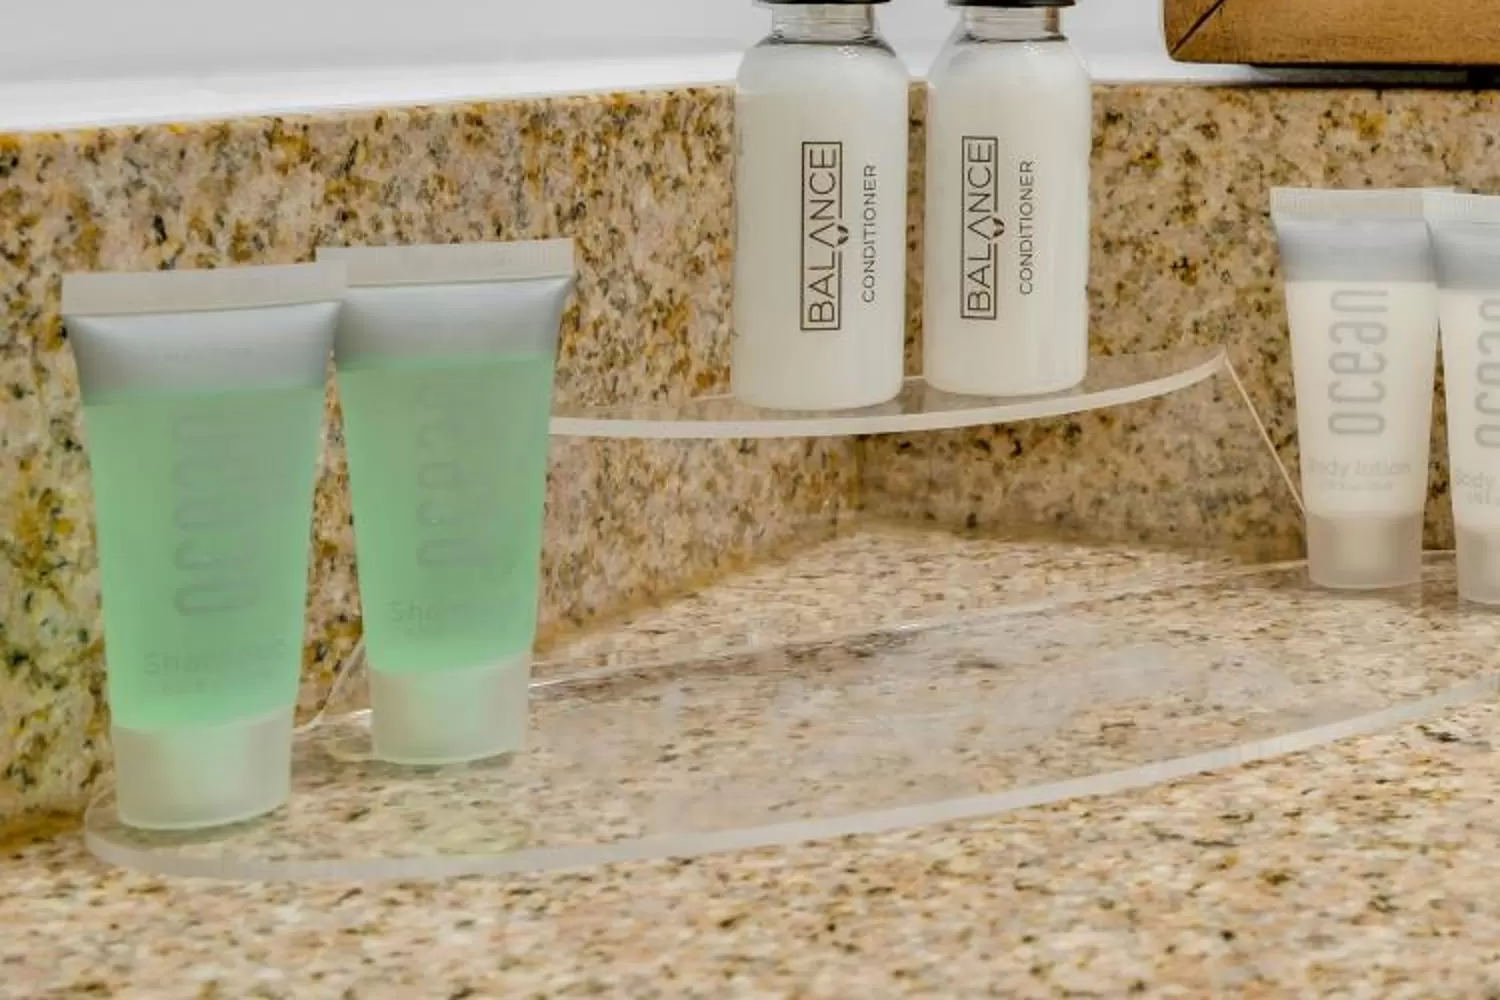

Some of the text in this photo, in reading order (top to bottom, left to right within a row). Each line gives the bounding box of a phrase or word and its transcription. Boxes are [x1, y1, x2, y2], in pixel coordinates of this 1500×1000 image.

[808, 146, 837, 324] BALANCE
[862, 164, 877, 304] CONDITIONER
[967, 142, 994, 312] BALANCE
[1019, 160, 1034, 295] CONDITIONER
[1327, 289, 1389, 438] ocean
